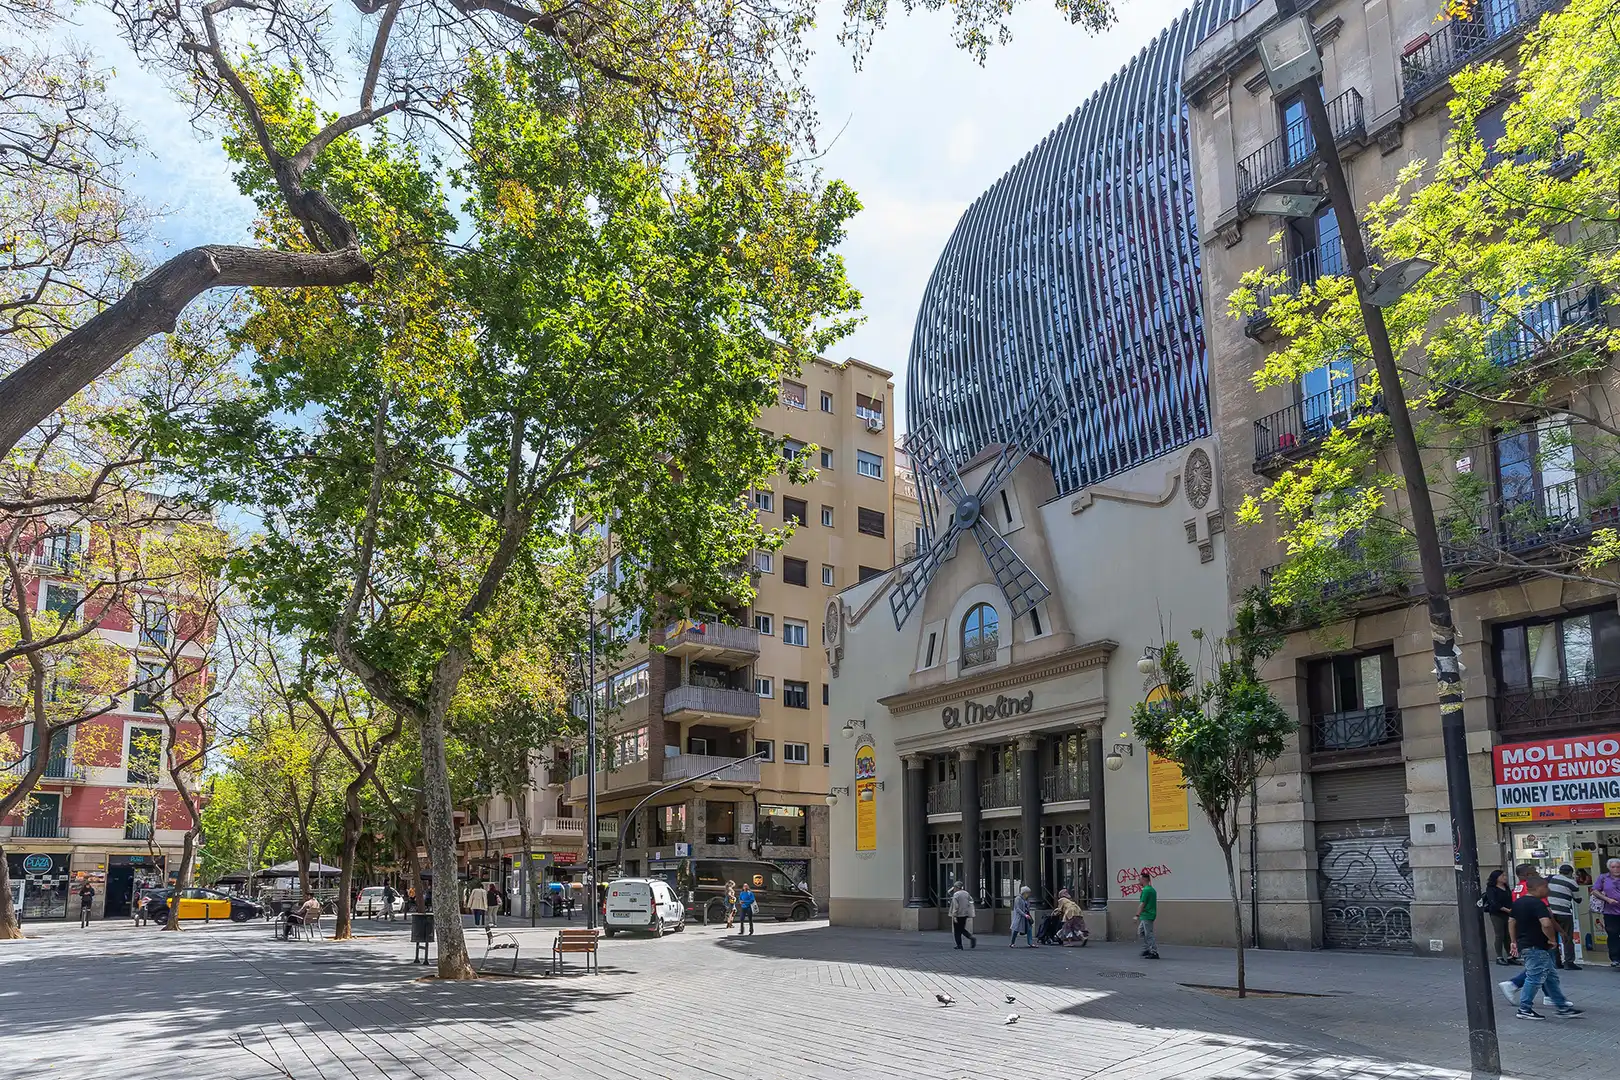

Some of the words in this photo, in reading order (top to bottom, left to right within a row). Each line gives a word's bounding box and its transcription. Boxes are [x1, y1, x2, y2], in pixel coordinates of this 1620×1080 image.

[1502, 739, 1619, 765] MOLINO
[1503, 765, 1540, 781] FOTO
[1543, 764, 1554, 778] Y
[1557, 757, 1620, 777] ENVIO'S
[1502, 785, 1548, 804] MONEY
[26, 856, 49, 868] PLAZA
